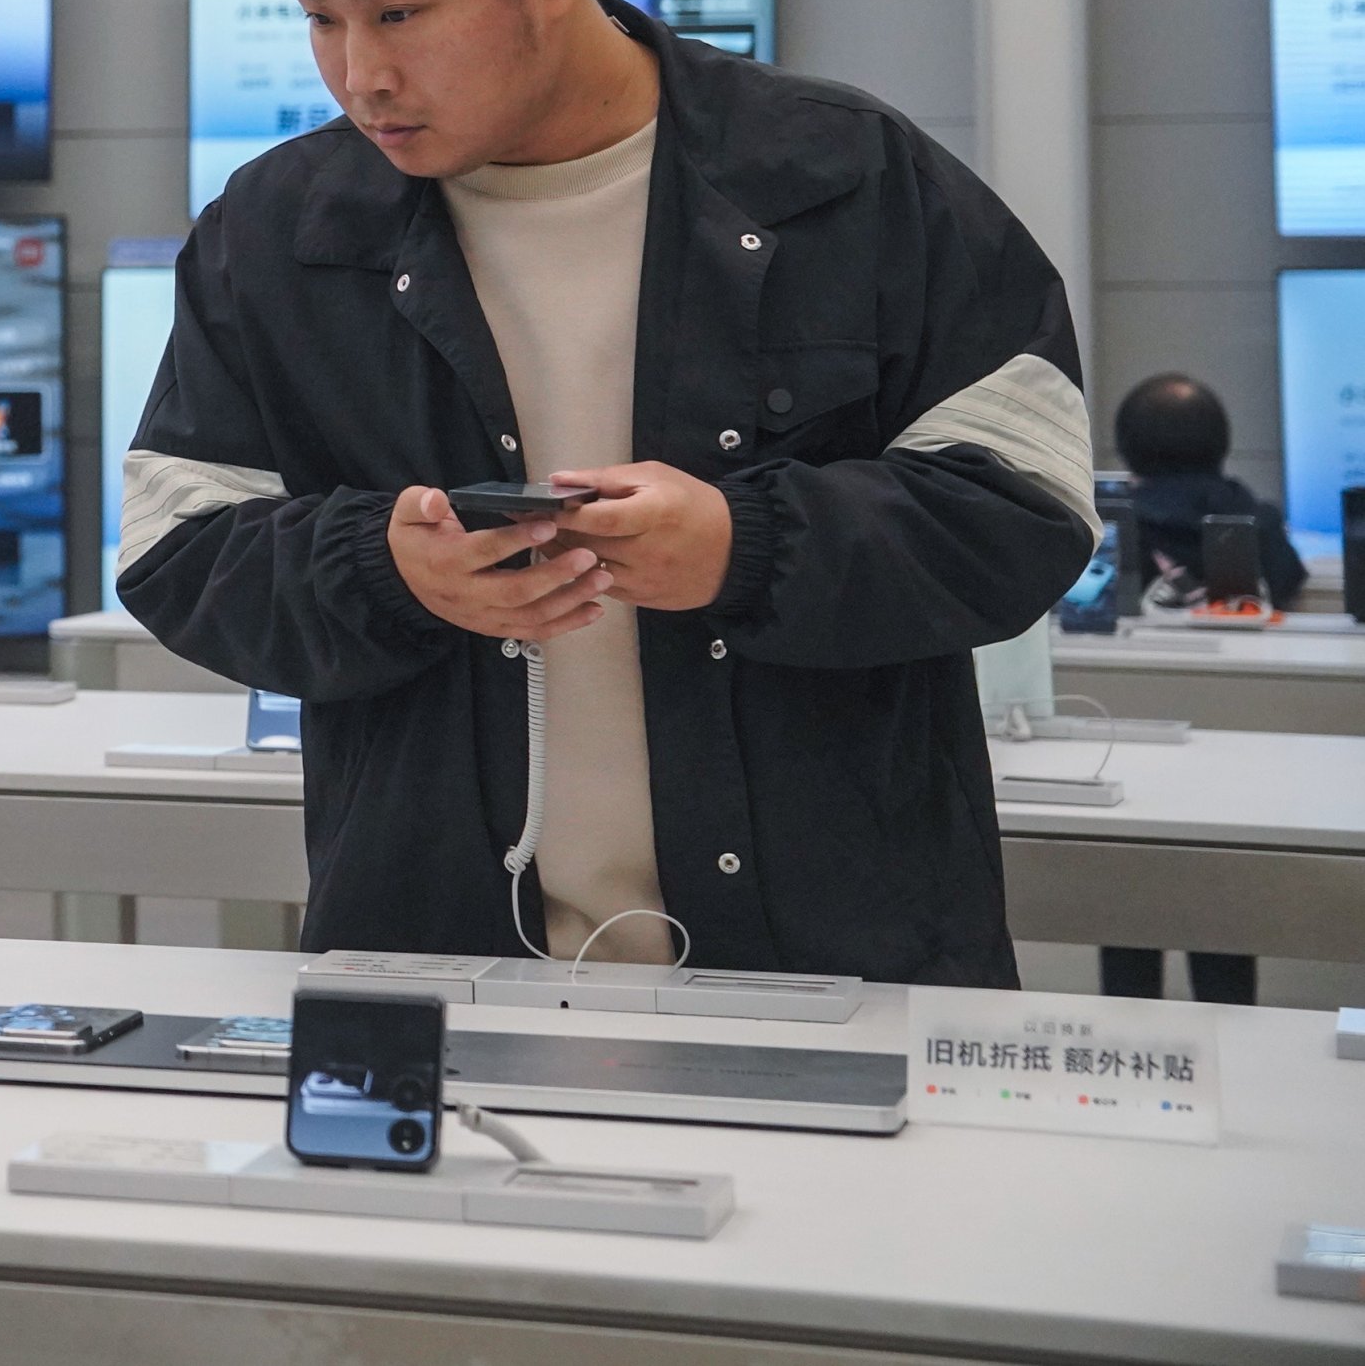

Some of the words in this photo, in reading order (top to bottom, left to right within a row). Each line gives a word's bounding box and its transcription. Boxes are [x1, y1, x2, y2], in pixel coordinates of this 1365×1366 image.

[926, 1037, 1052, 1072] 旧机折抵
[1063, 1046, 1194, 1082] 额外补贴
